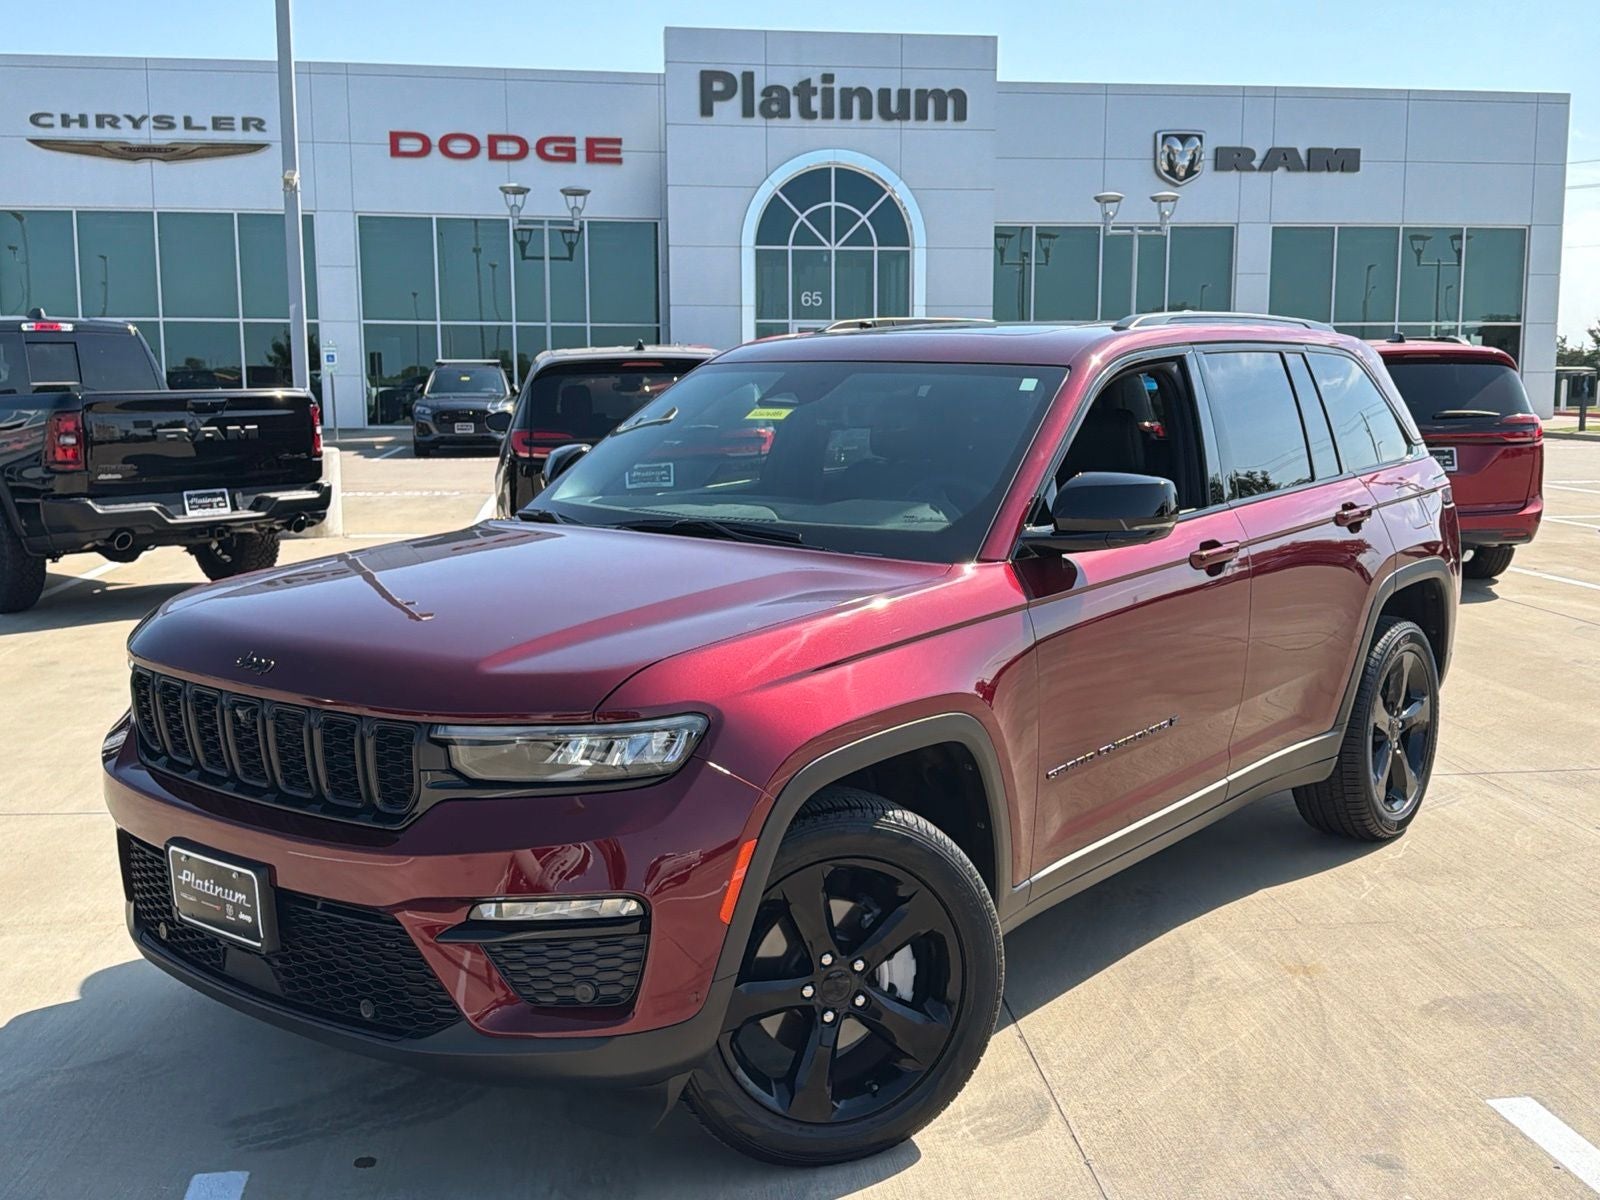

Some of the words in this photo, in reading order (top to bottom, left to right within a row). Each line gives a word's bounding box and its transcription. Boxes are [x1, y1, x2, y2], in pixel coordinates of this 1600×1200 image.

[699, 69, 968, 122] Platinum
[28, 111, 268, 133] CHRYSLER
[388, 130, 624, 165] DODGE
[1213, 146, 1361, 172] RAM
[800, 291, 823, 307] 65
[156, 424, 260, 442] RAM
[177, 869, 252, 908] Platinum
